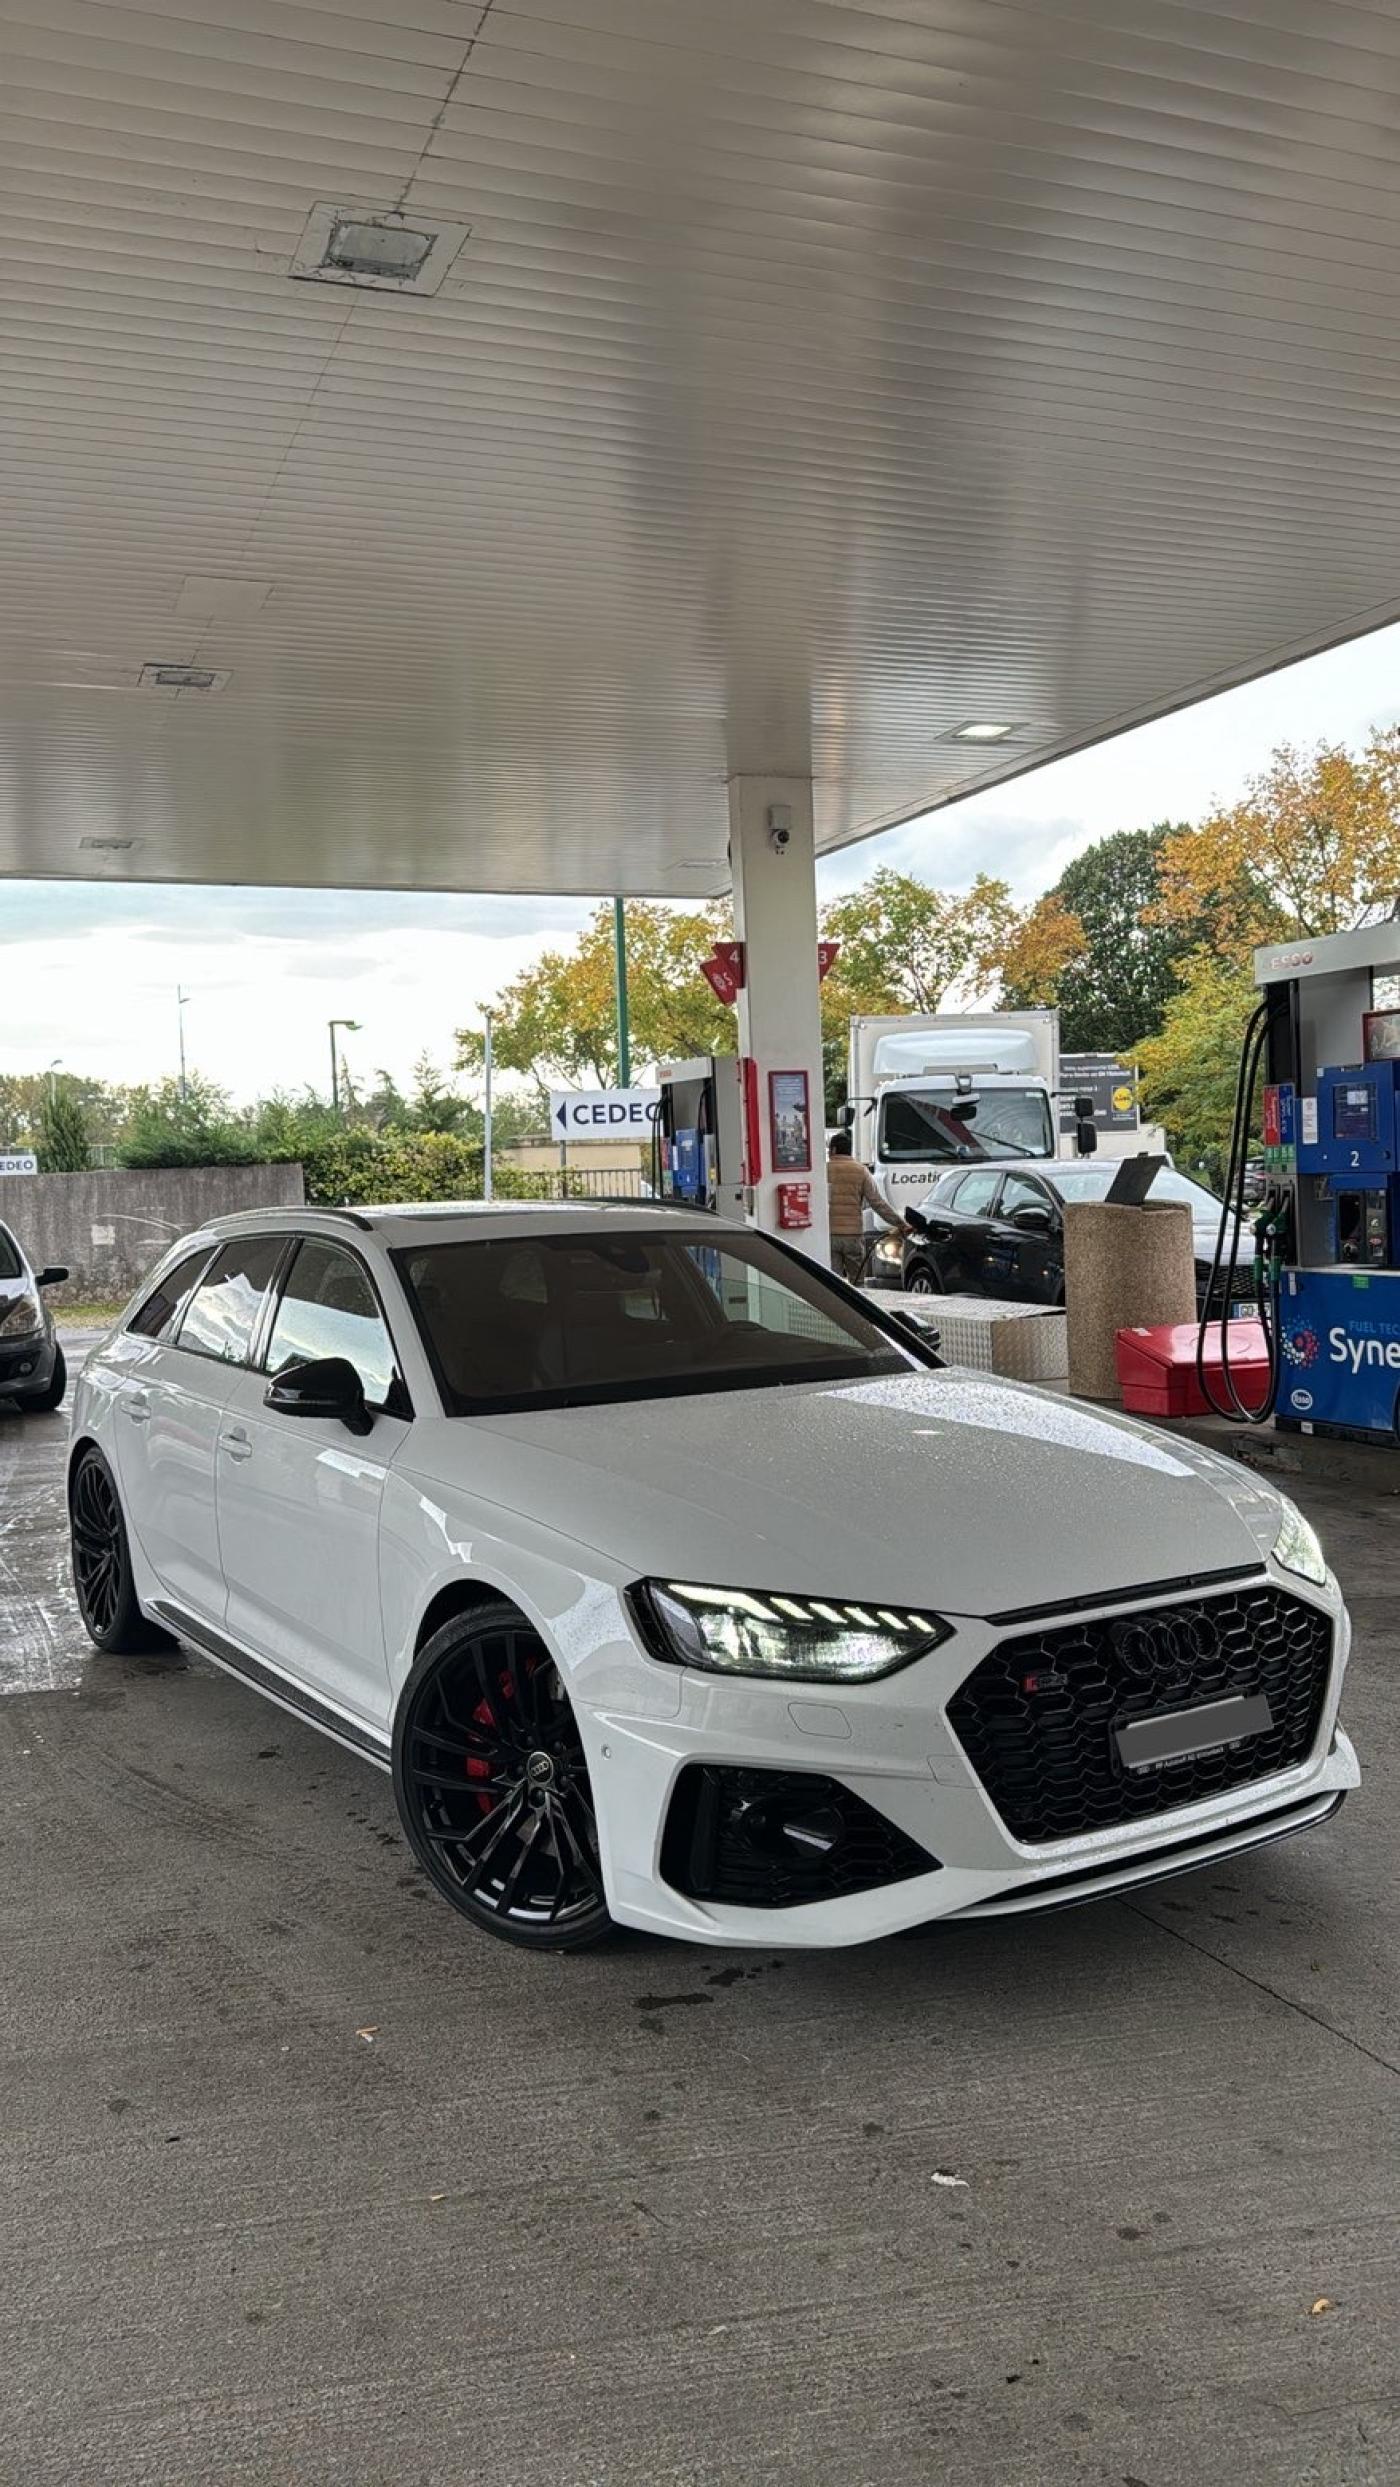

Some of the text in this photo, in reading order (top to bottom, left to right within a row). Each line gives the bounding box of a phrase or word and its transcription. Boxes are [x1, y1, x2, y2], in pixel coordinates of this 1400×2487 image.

[729, 949, 740, 963] 4
[819, 950, 828, 965] 3
[1271, 951, 1313, 970] ESSO
[1350, 1150, 1360, 1167] 2
[1329, 1327, 1400, 1374] Syne
